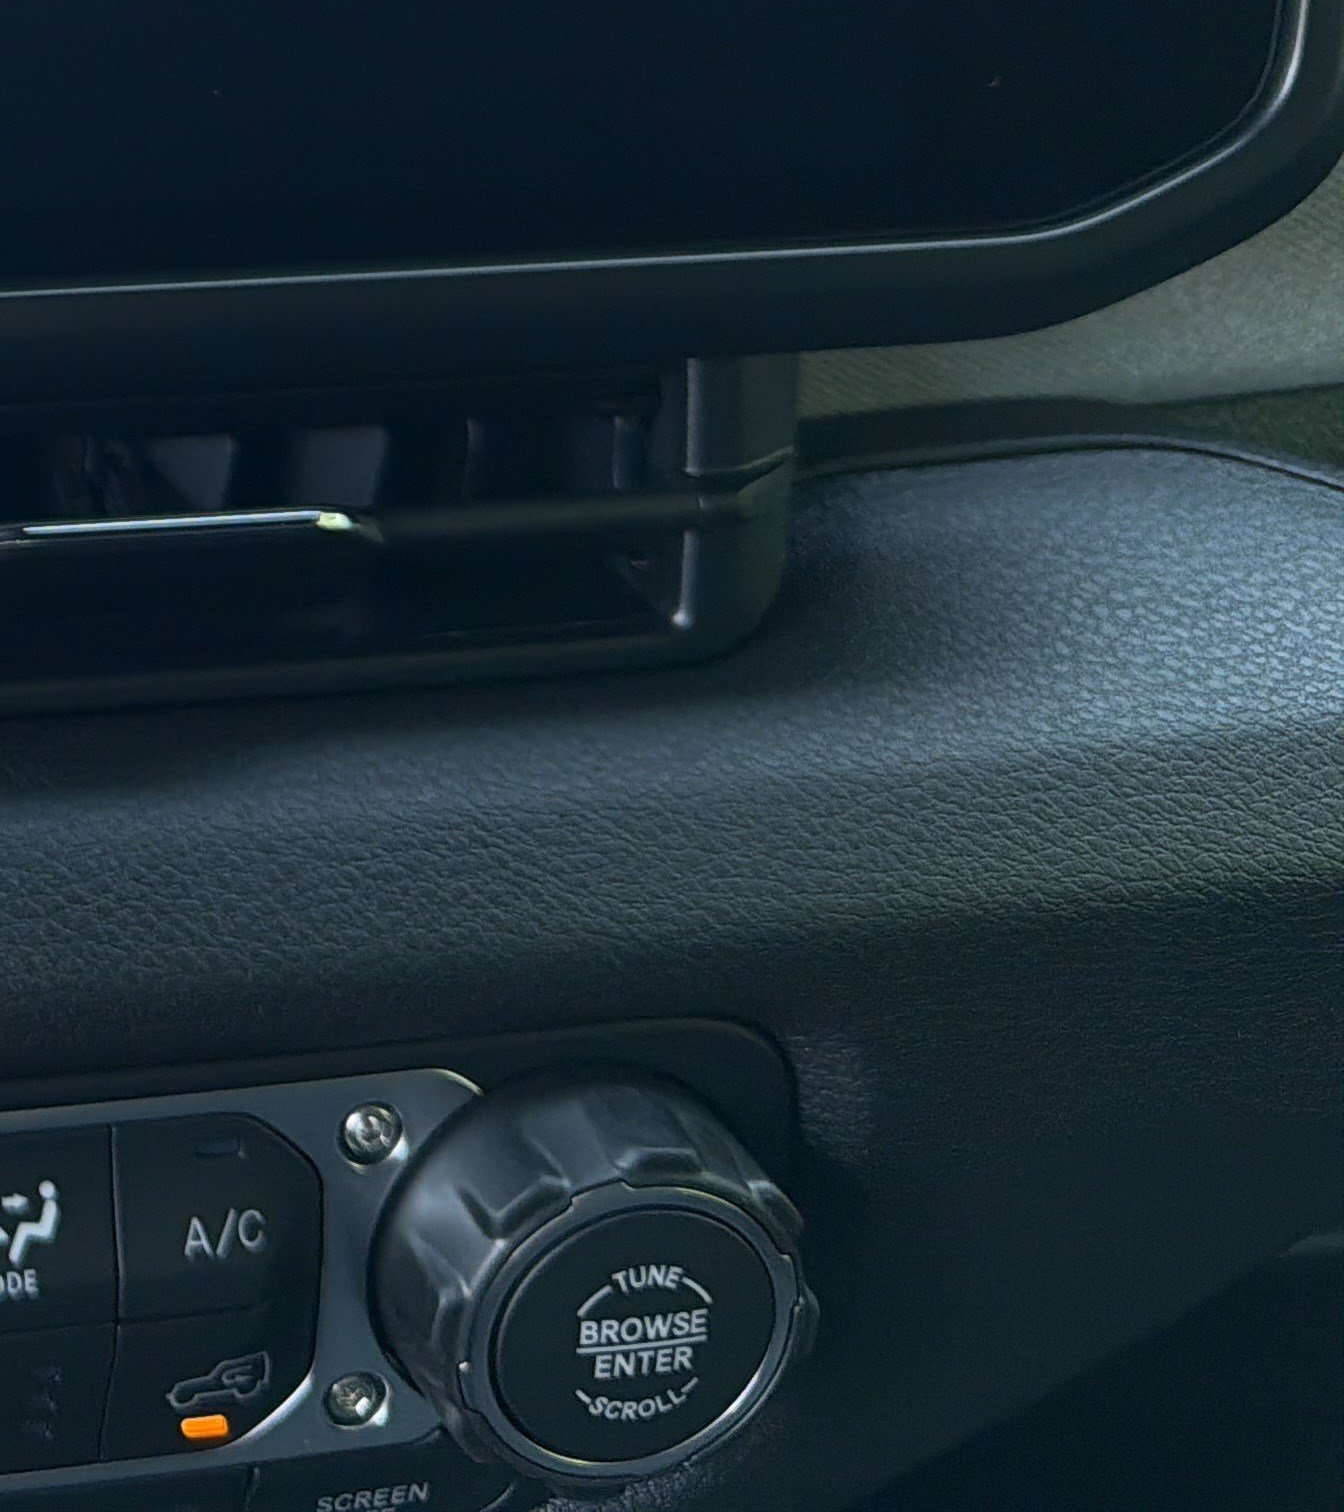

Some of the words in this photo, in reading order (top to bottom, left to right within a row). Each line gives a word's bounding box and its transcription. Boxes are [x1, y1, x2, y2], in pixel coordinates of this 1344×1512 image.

[183, 1206, 268, 1260] A/C
[611, 1264, 685, 1295] TUNE
[578, 1308, 709, 1346] BROWSE
[593, 1345, 695, 1381] ENTER
[587, 1388, 686, 1422] SCROLL
[316, 1481, 431, 1512] SCREEN
